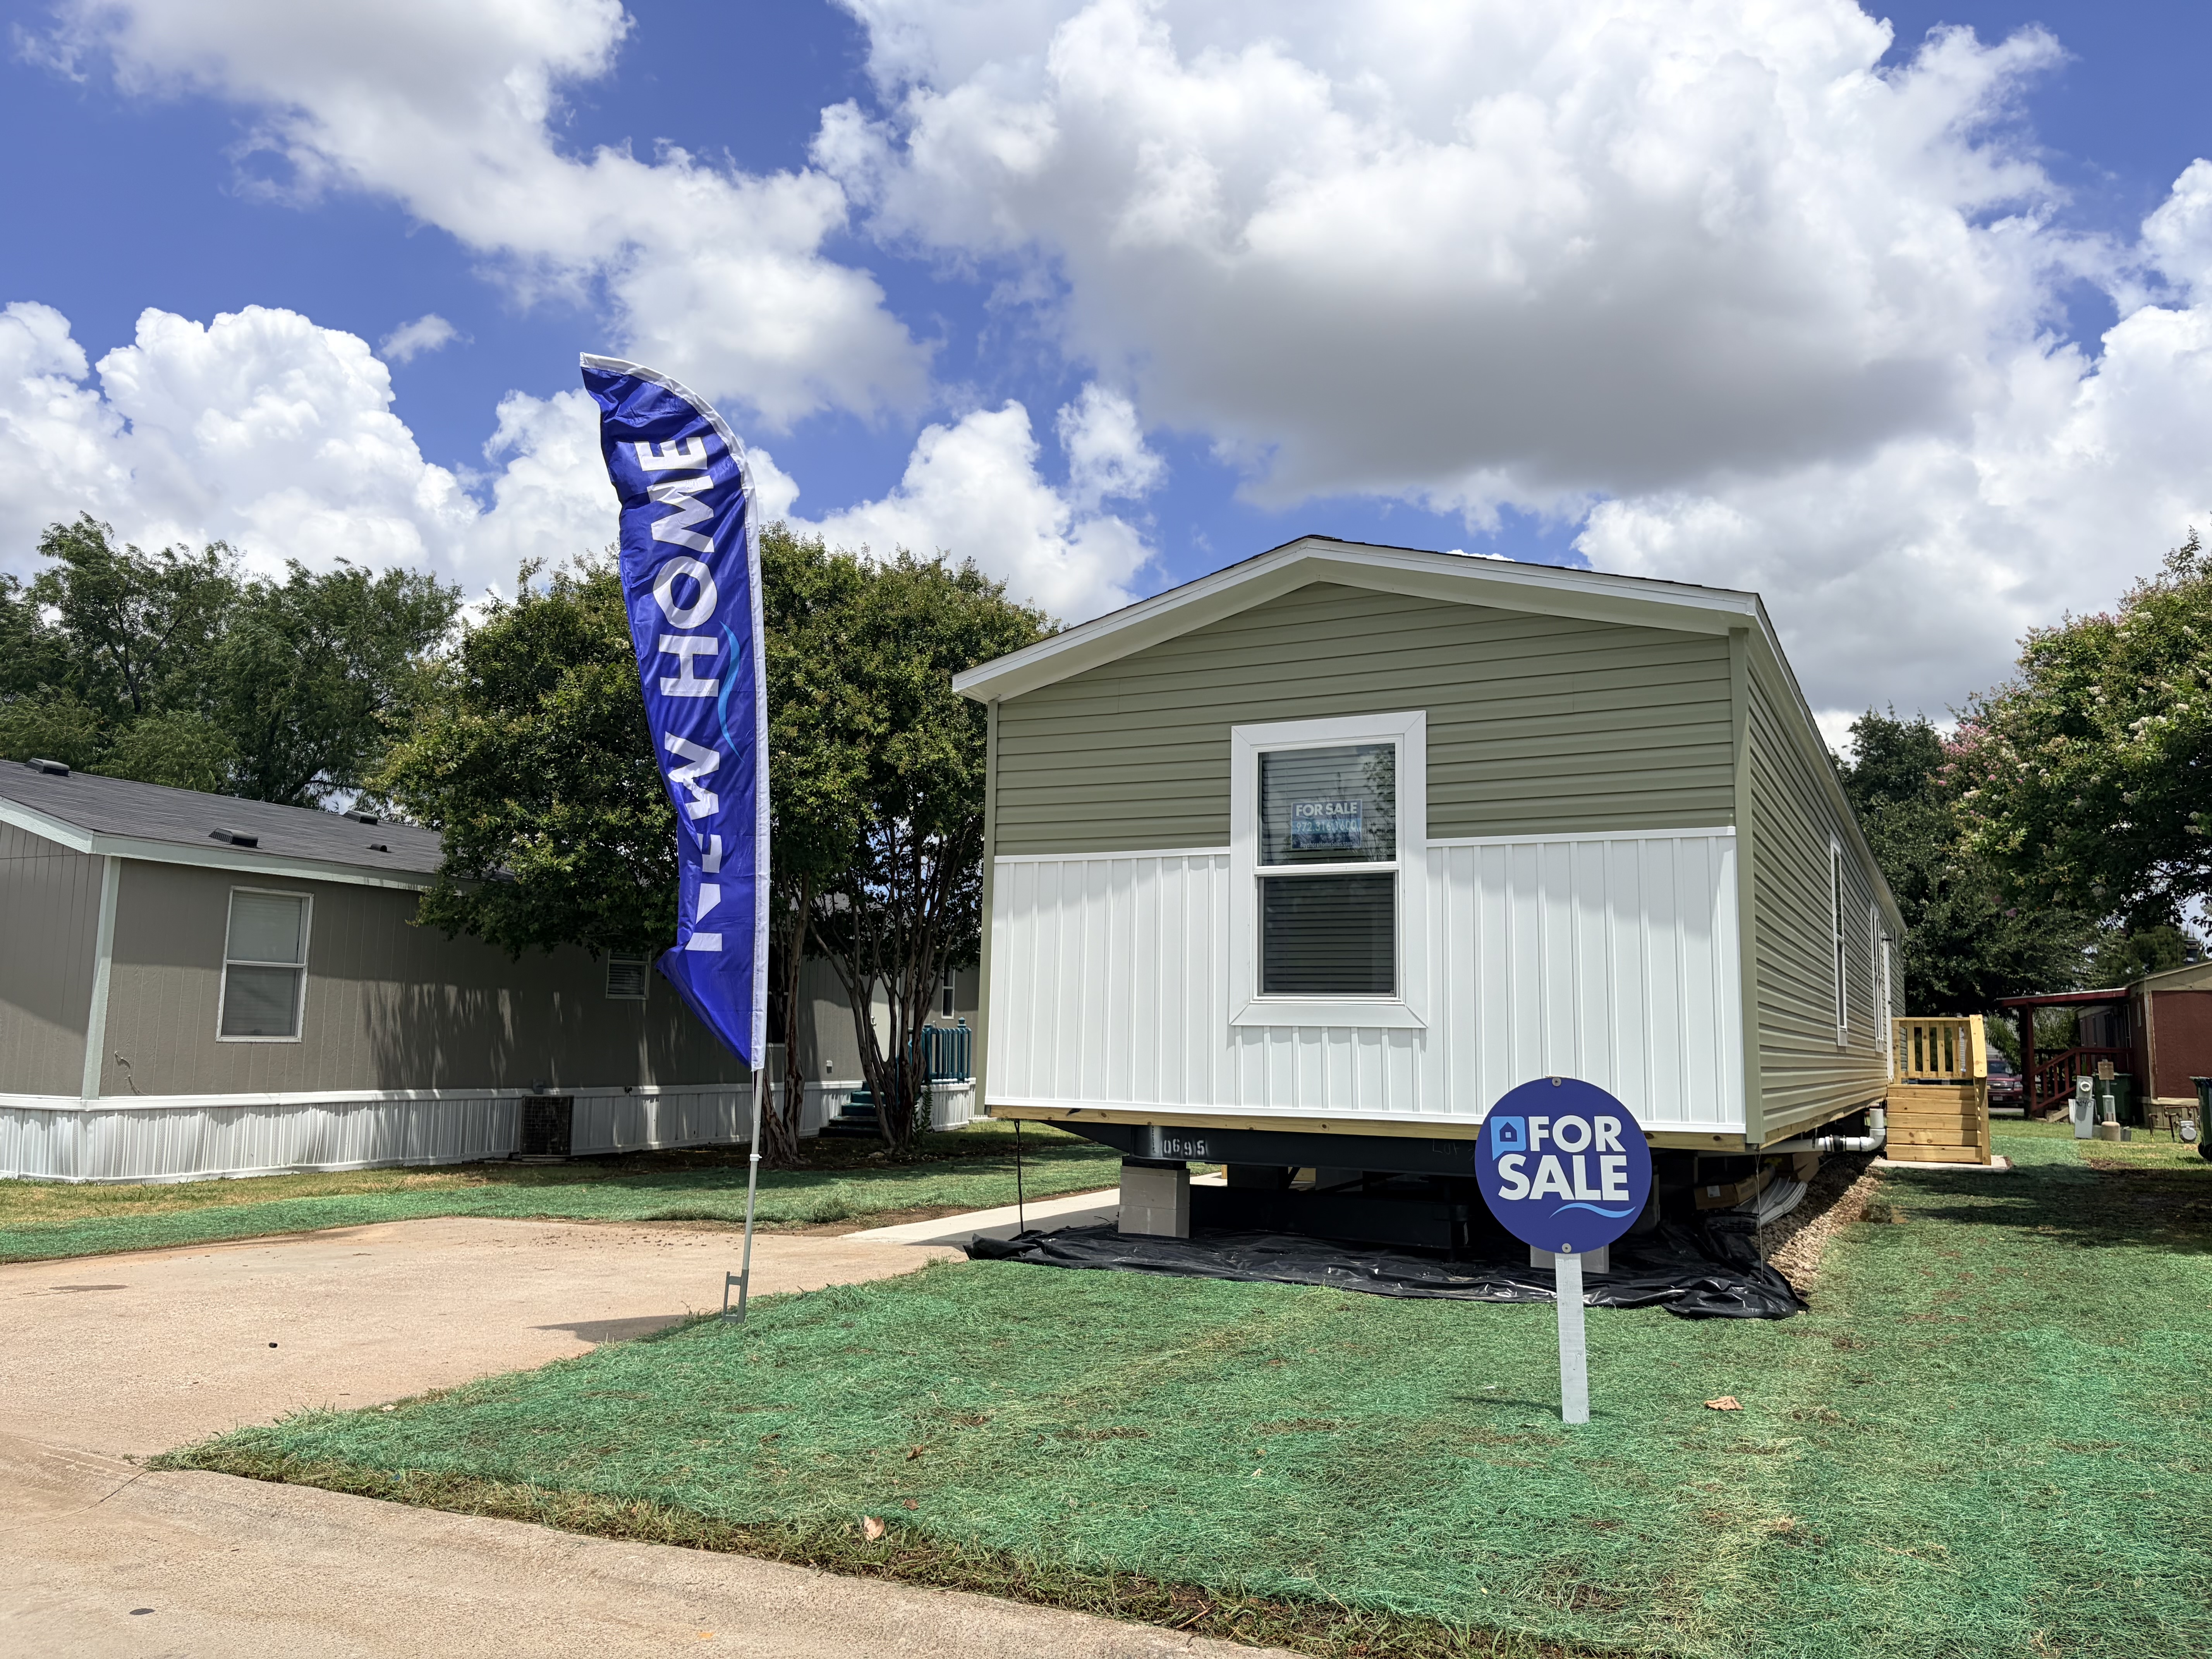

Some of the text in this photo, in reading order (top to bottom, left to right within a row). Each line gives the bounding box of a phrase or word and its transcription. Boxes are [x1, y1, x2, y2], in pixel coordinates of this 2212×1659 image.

[634, 436, 719, 697] HOME
[1296, 802, 1357, 816] FOR SALE
[1164, 1139, 1205, 1156] 0695
[1528, 1115, 1626, 1153] FOR
[1498, 1153, 1630, 1201] SALE
